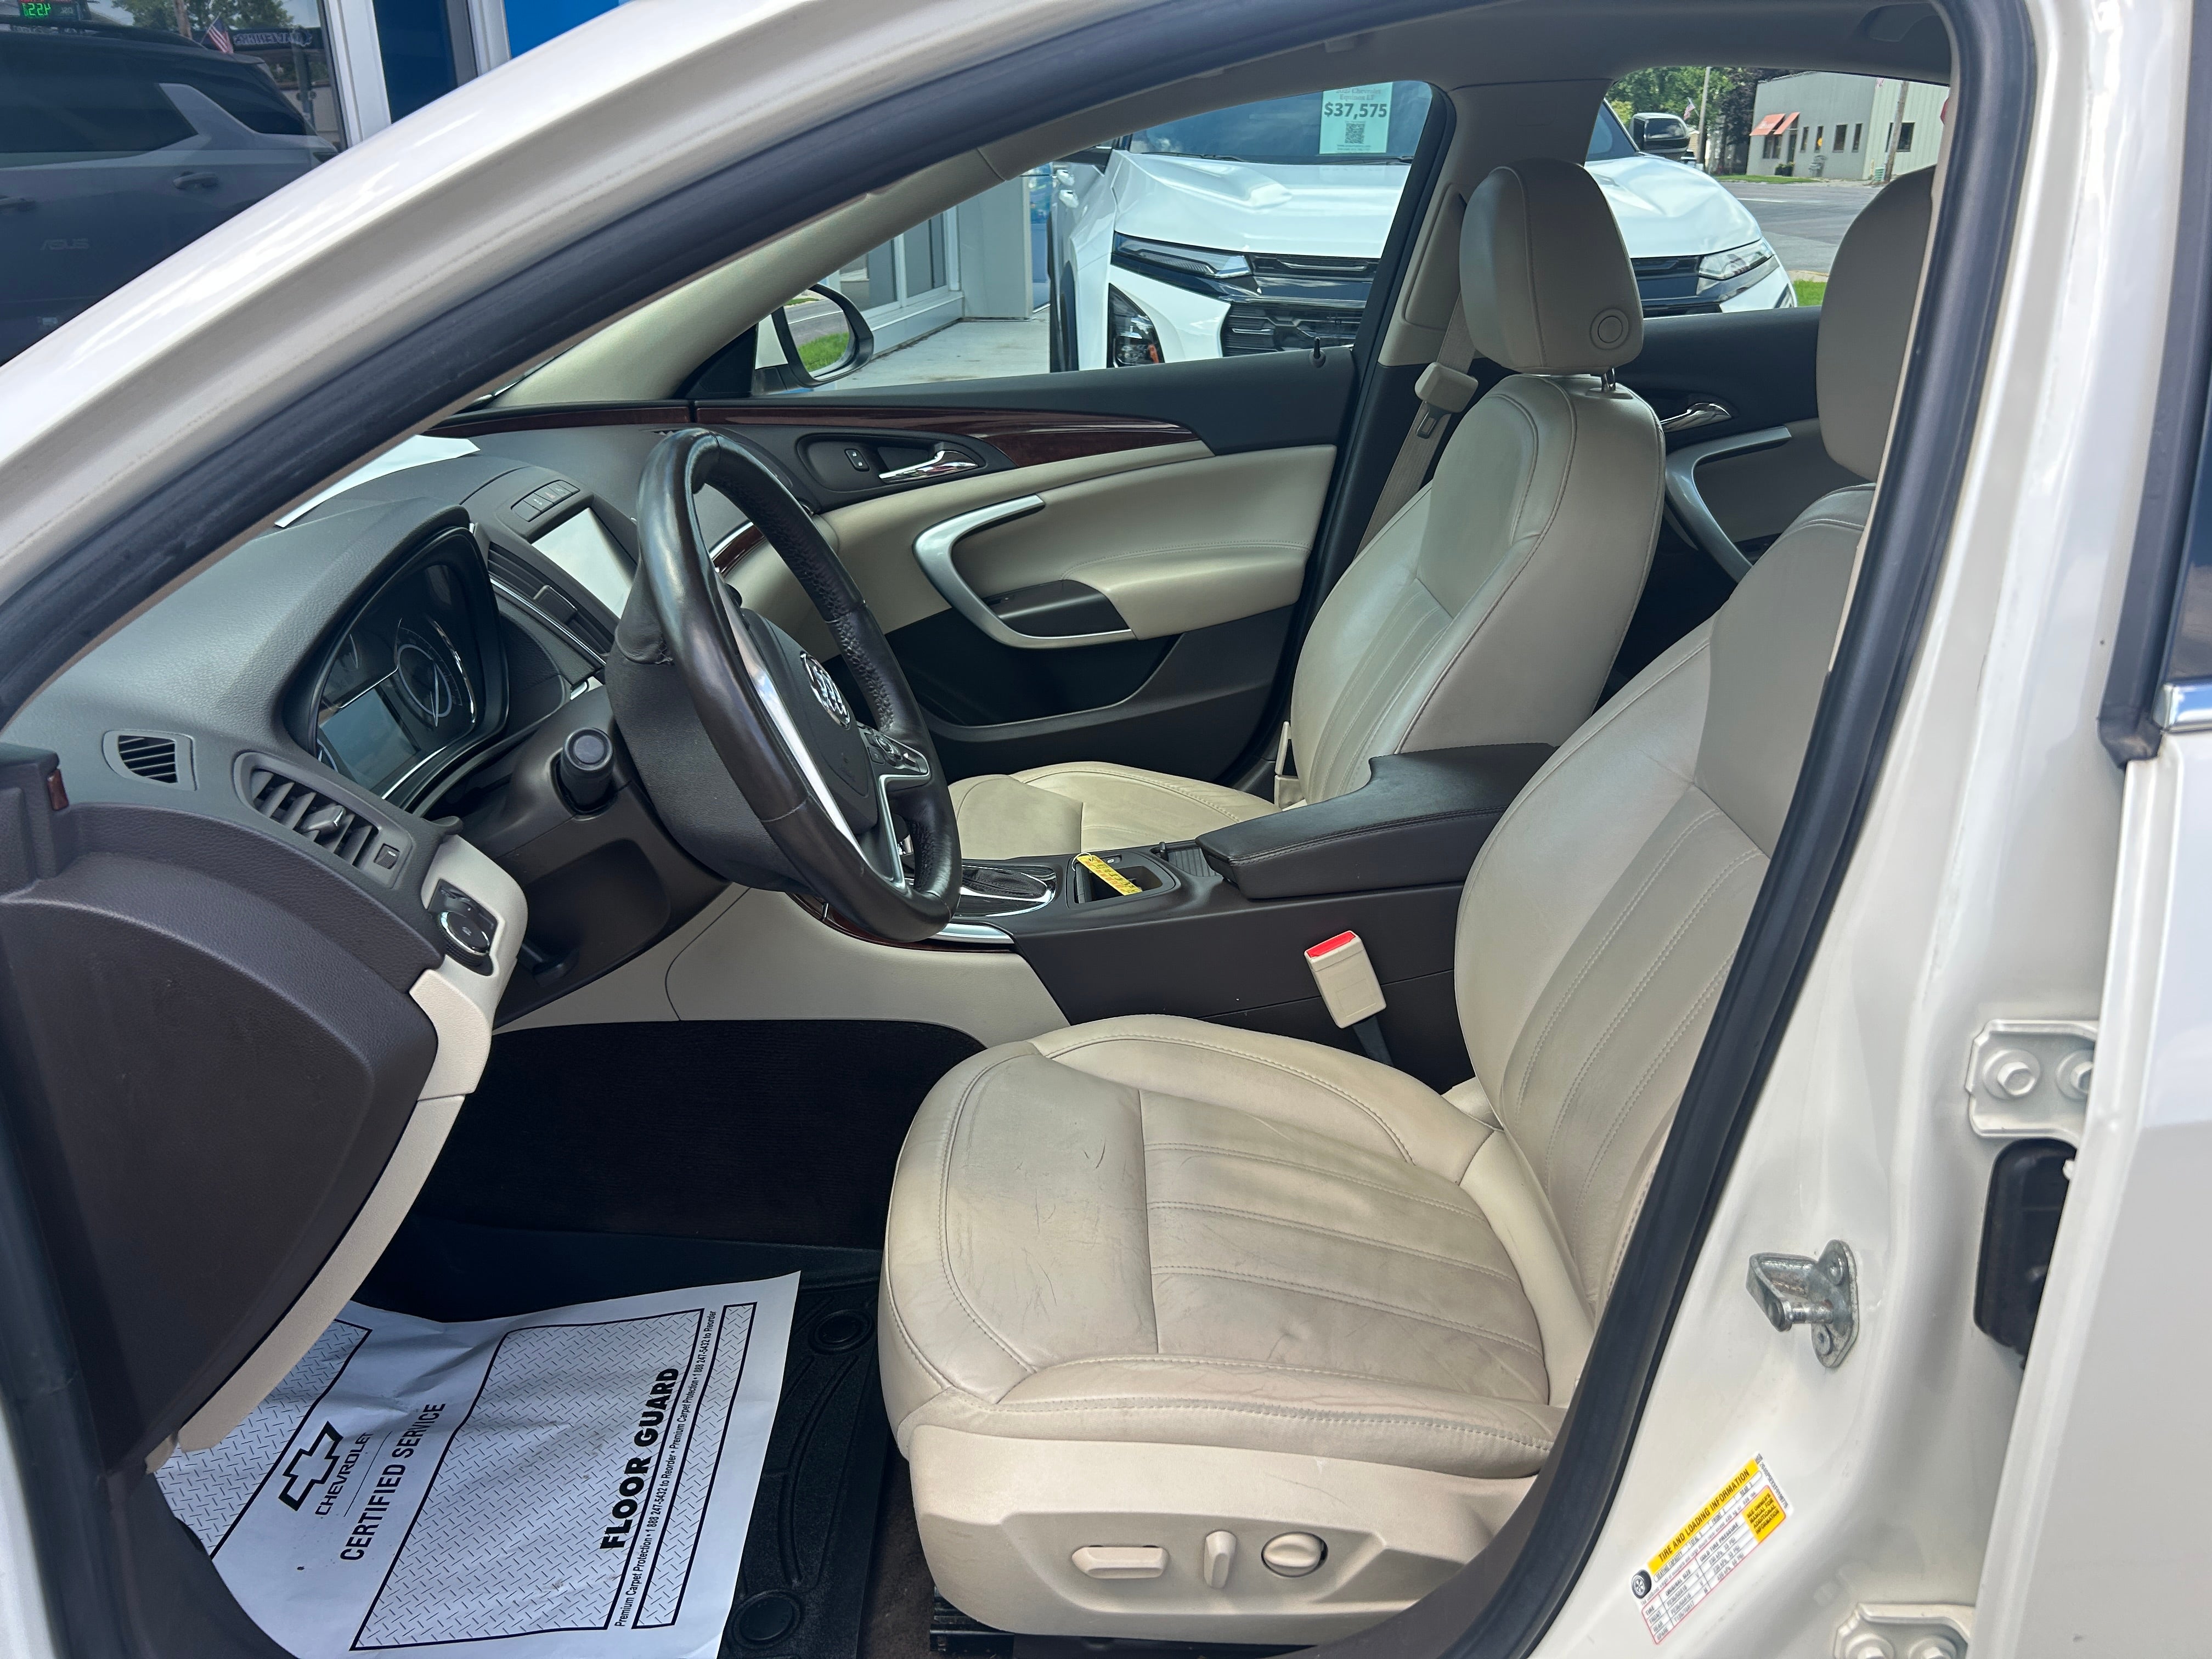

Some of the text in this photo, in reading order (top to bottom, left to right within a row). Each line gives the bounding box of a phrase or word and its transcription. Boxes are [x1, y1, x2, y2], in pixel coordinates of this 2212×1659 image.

[1324, 101, 1387, 120] $37,575
[40, 238, 89, 250] ASUS
[703, 1311, 717, 1333] Reorder
[697, 1339, 710, 1363] 247-5432
[694, 1363, 703, 1375] 888
[685, 1380, 699, 1406] Protection
[677, 1400, 690, 1423] Carpet
[669, 1422, 685, 1449] Premium
[600, 1368, 679, 1549] FLOOR GUARD
[665, 1453, 676, 1479] Reorder
[315, 1432, 374, 1515] CHEVROLET
[340, 1403, 446, 1560] CERTIFIED SERVICE
[651, 1487, 668, 1517] 247-5432
[1740, 1486, 1749, 1496] REAR
[647, 1516, 659, 1529] 888
[1658, 1469, 1750, 1562] TIRE AND LOADING INFORMATION
[1712, 1513, 1722, 1524] FRONT
[1750, 1498, 1774, 1523] MANUAL FOR
[1753, 1504, 1776, 1528] ADDITIONAL
[1755, 1509, 1780, 1534] INFORMATION
[1689, 1536, 1699, 1547] TOTAL
[1700, 1522, 1739, 1561] COLD TIRE PRESSURE
[635, 1538, 652, 1572] Protection
[1656, 1551, 1683, 1579] SEATING CAPACITY
[625, 1571, 642, 1596] Carpet
[1666, 1569, 1691, 1596] ORIGINAL SIZE
[614, 1597, 635, 1627] Premium
[1645, 1605, 1655, 1616] TIRE
